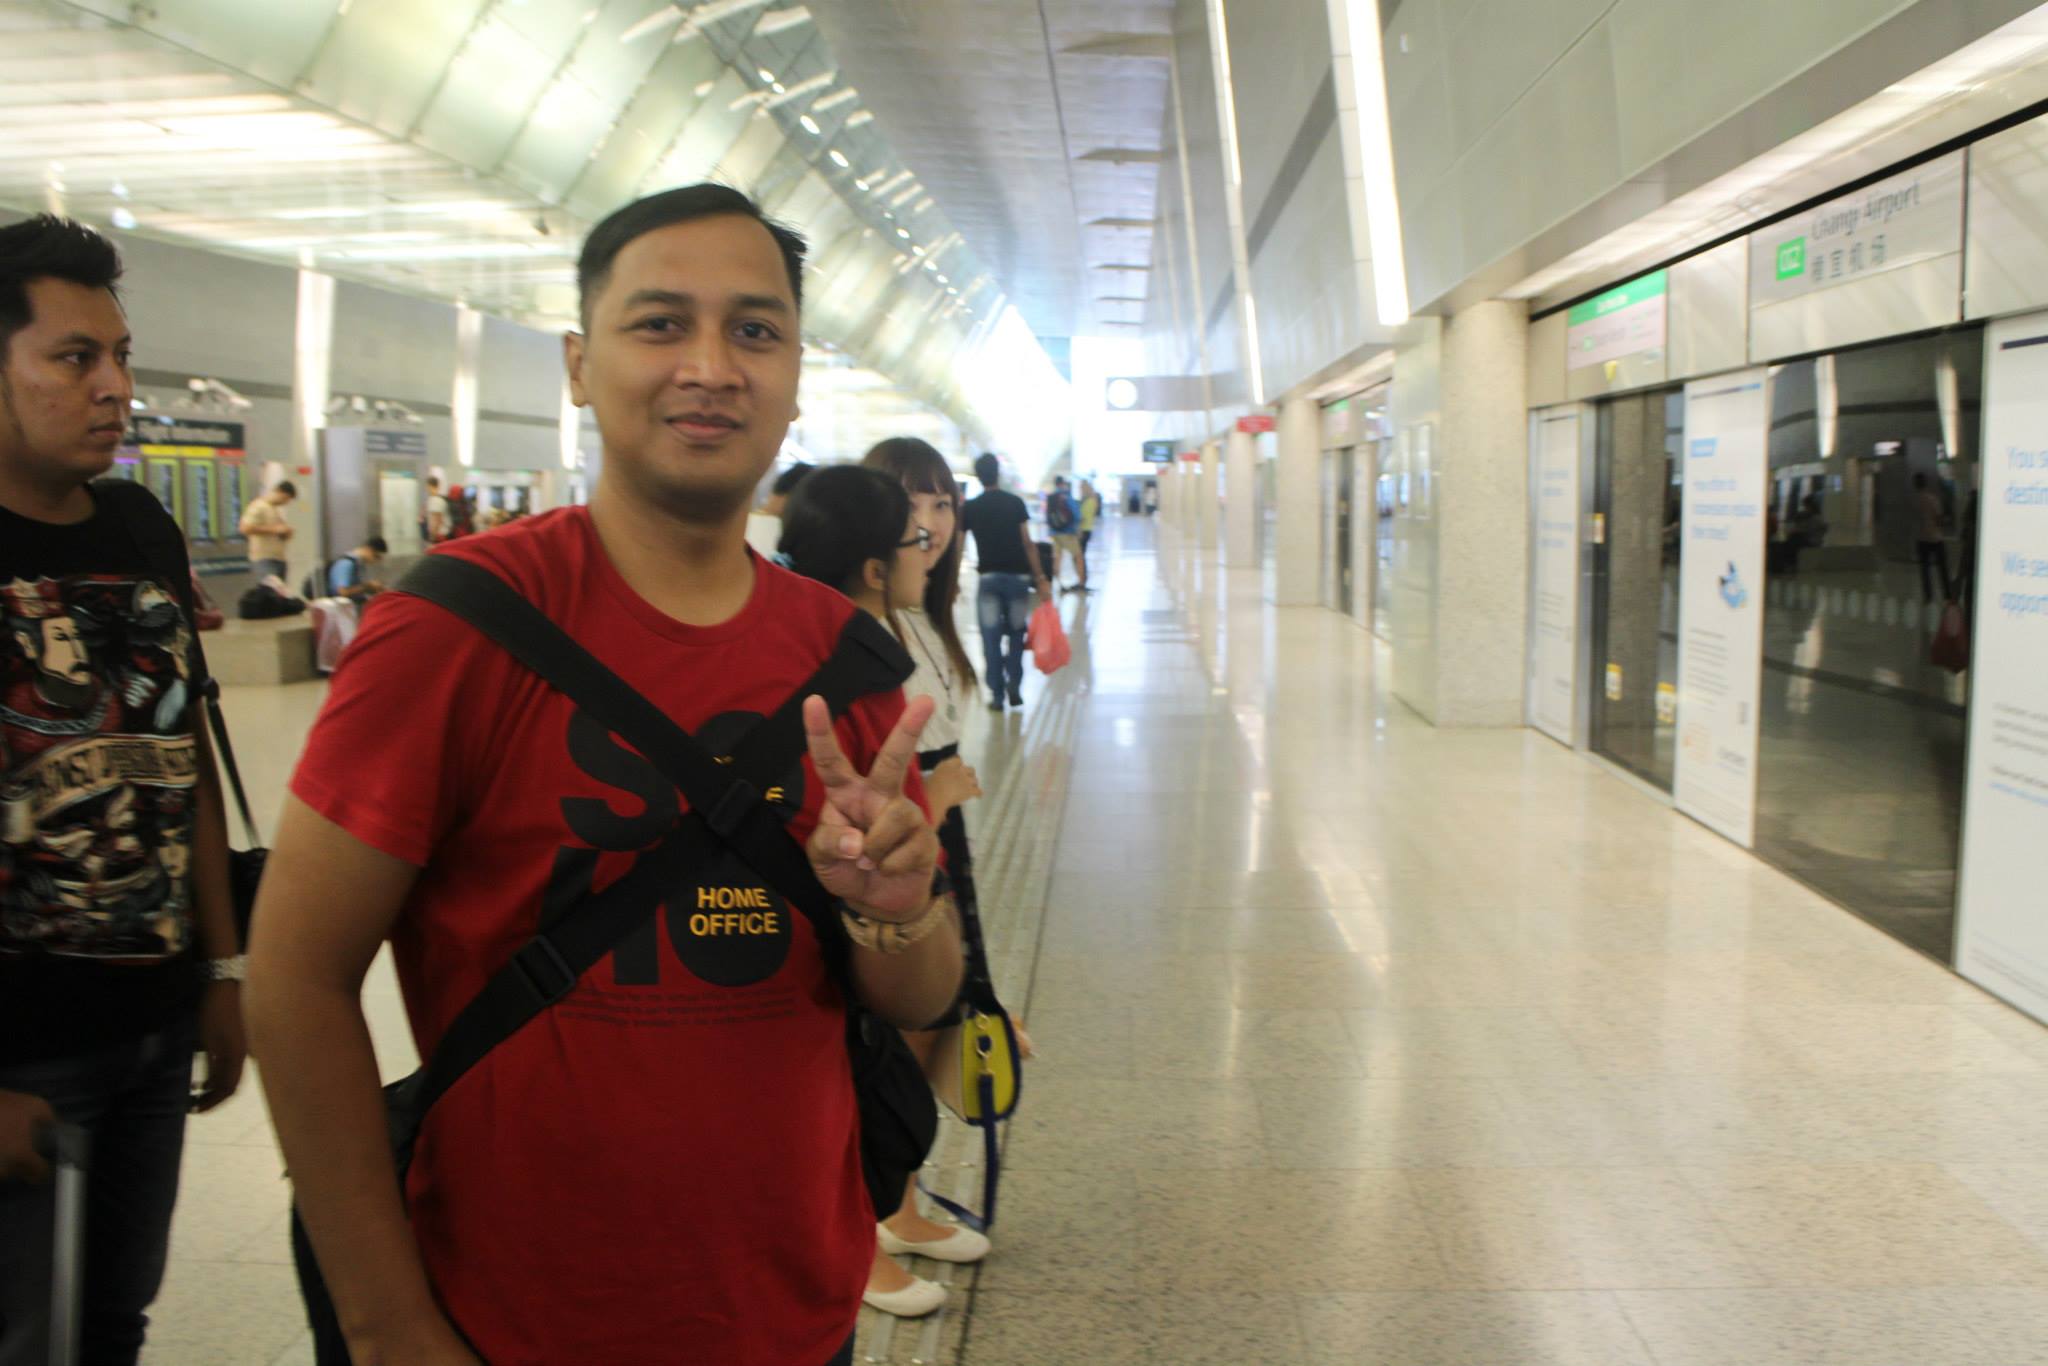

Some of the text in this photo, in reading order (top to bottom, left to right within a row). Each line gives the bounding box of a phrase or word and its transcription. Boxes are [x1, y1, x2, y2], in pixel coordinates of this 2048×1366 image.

[1864, 180, 1920, 223] Airport
[697, 887, 771, 909] HOME
[689, 912, 779, 936] OFFICE
